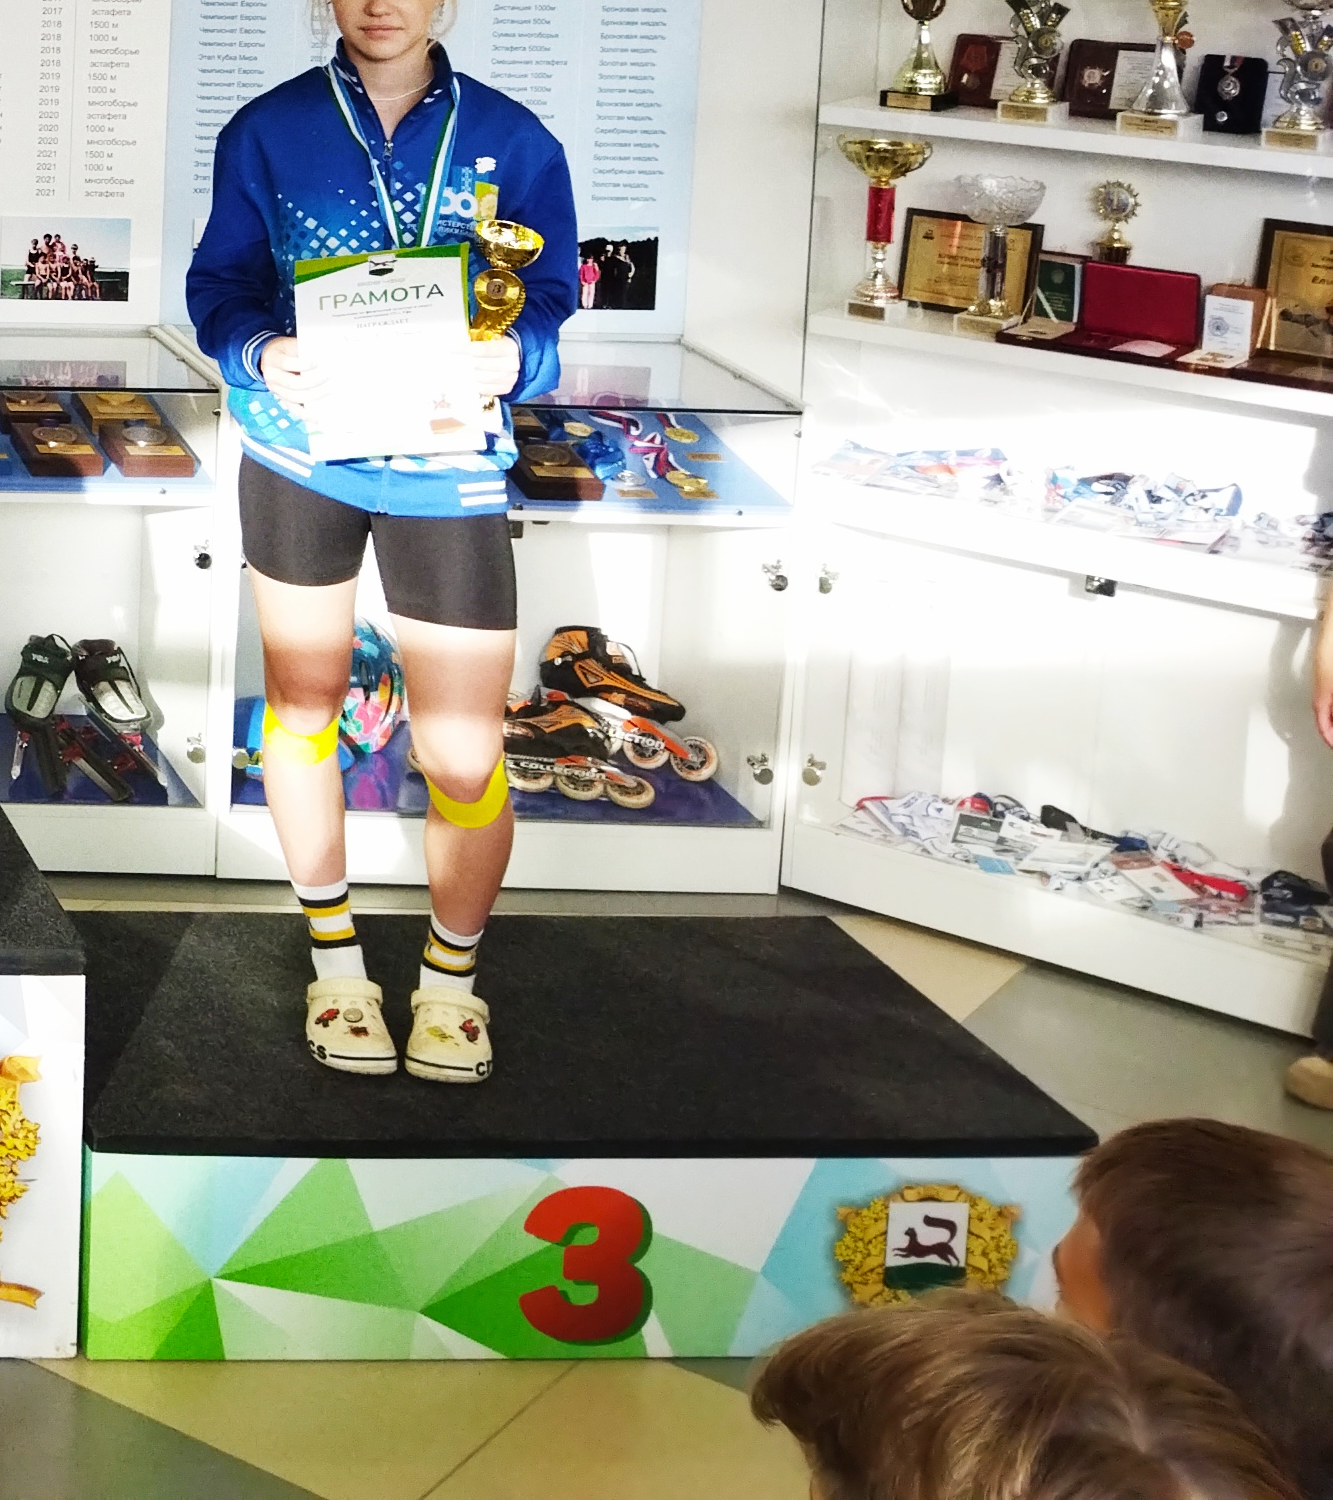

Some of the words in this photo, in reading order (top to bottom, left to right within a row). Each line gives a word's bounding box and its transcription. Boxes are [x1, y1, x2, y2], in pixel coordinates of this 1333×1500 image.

[42, 6, 63, 17] 2017
[35, 188, 56, 198] 2021
[319, 284, 444, 310] ГРАМОТА
[519, 1185, 653, 1345] 3
